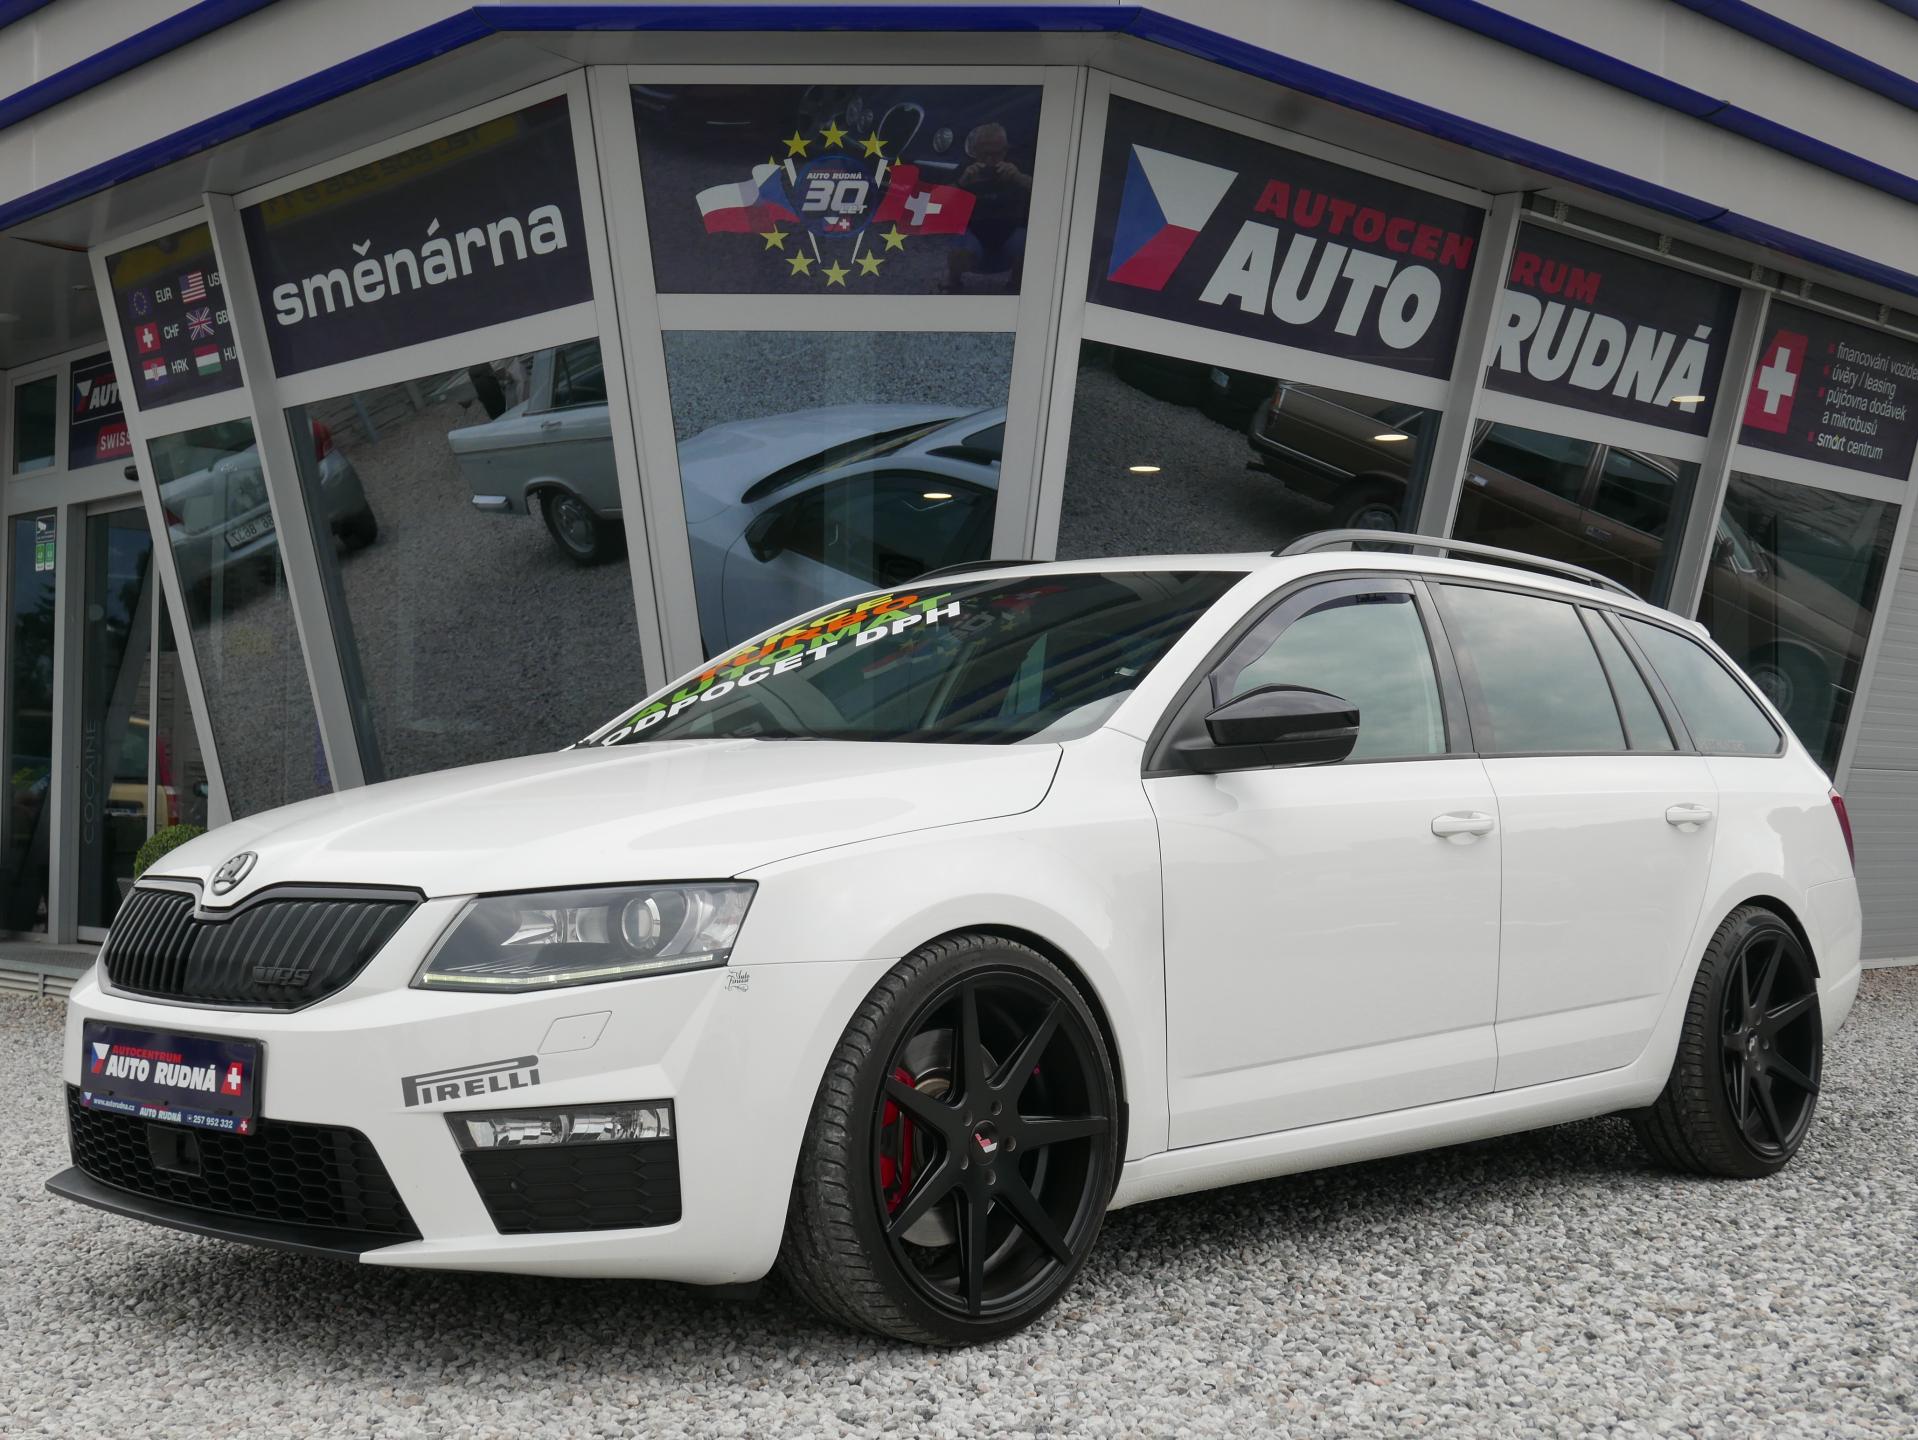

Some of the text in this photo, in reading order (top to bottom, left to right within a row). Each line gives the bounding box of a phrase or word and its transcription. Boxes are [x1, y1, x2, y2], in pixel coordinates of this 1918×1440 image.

[807, 172, 830, 180] AUTO
[802, 180, 870, 212] 30
[1254, 178, 1474, 270] AUTOCEN
[272, 204, 568, 326] směnárna
[207, 272, 221, 287] US
[155, 287, 173, 303] EUR
[216, 310, 229, 325] GB
[1198, 219, 1710, 413] AUTO RUDNÁ
[163, 323, 180, 340] CHF
[171, 358, 189, 374] HRK
[223, 346, 237, 361] HU
[1837, 342, 1891, 373] financování
[89, 382, 121, 410] AUT
[1832, 364, 1858, 390] úvěry
[1864, 373, 1897, 400] leasing
[1869, 397, 1908, 422] dodávek
[1817, 432, 1884, 460] smart centrum
[692, 595, 919, 681] TURBO
[855, 601, 960, 647] DPH
[624, 592, 952, 727] AUTOMAT
[112, 1044, 183, 1063] AUTOCENTRUM
[105, 1054, 216, 1093] AUTO RUDNÁ
[401, 1054, 541, 1107] PIRELLI
[139, 1106, 157, 1118] AUTO
[158, 1110, 182, 1122] RUDNÁ
[193, 1114, 233, 1129] 257 952 332
